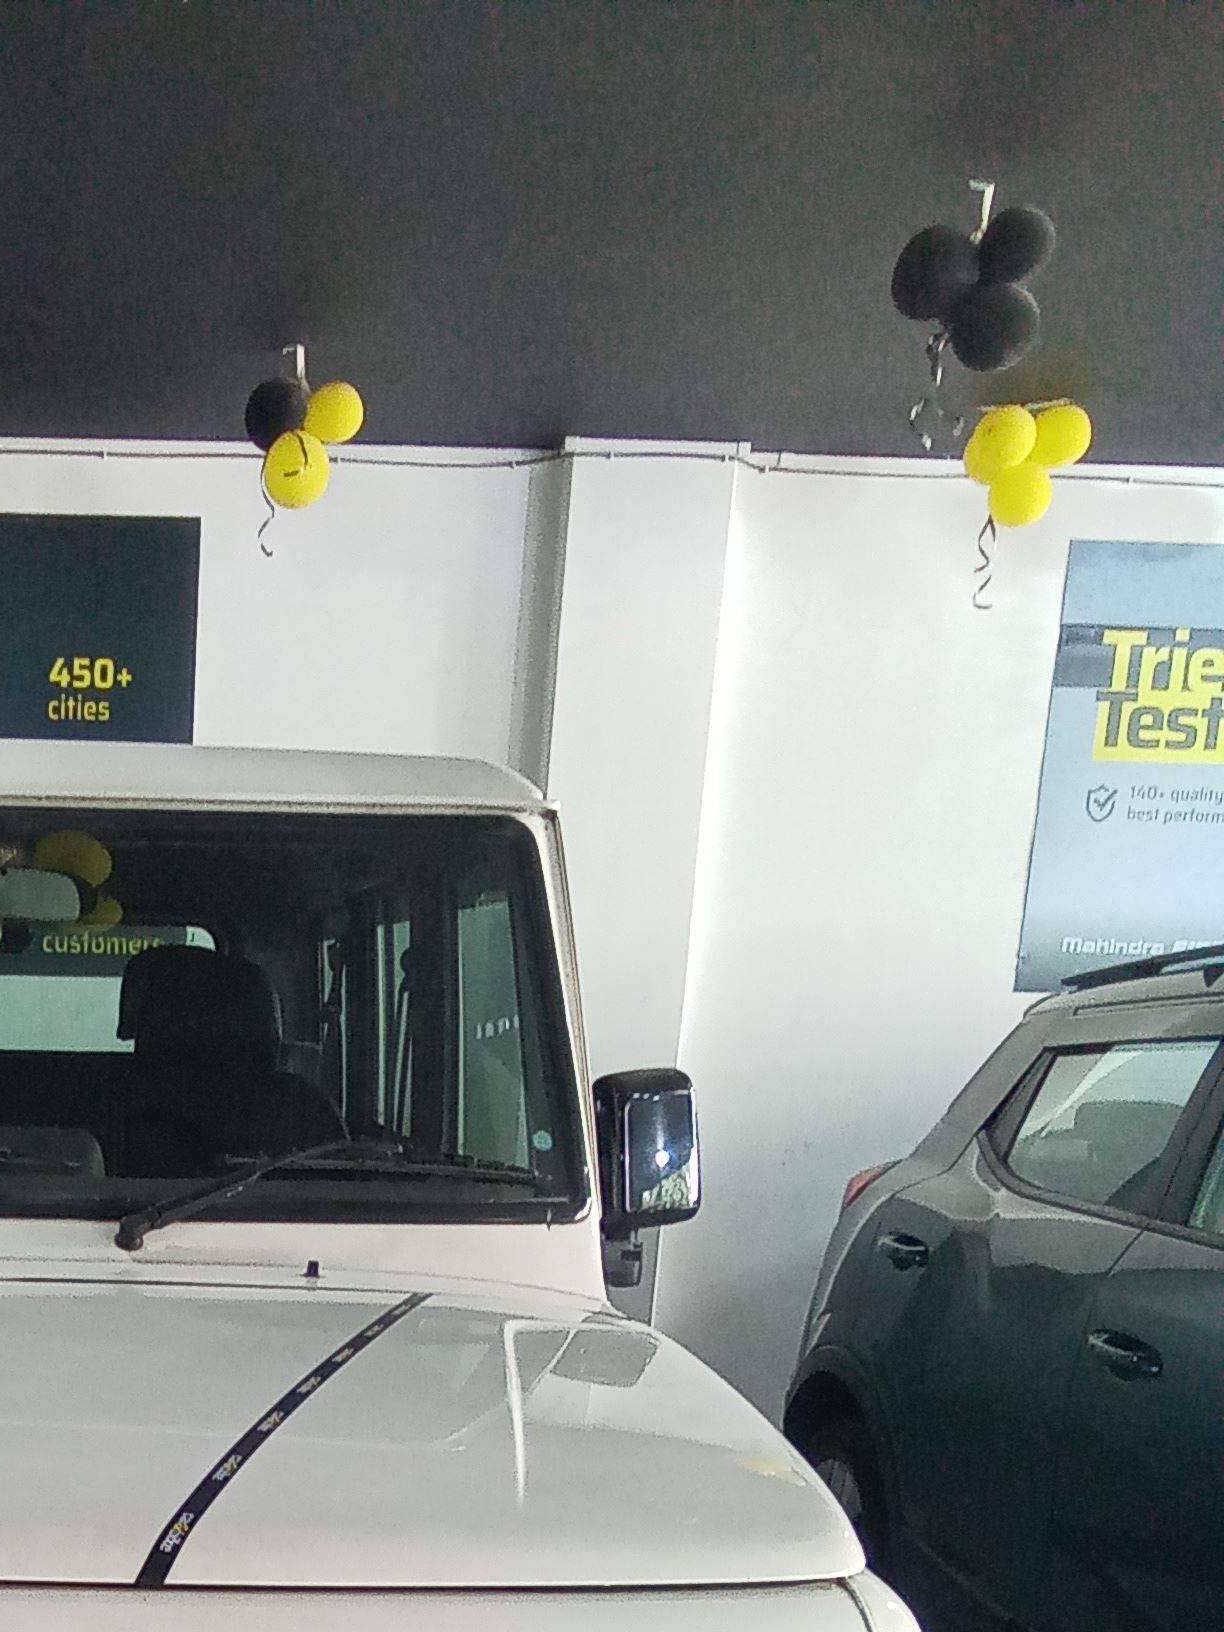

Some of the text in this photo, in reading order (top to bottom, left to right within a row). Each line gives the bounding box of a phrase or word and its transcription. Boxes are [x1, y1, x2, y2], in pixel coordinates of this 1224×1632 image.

[48, 657, 133, 689] 450+
[1102, 627, 1224, 693] Trie
[47, 693, 111, 722] cities
[1095, 690, 1224, 751] Test
[1129, 785, 1224, 805] 140+ quality
[1127, 806, 1158, 821] best
